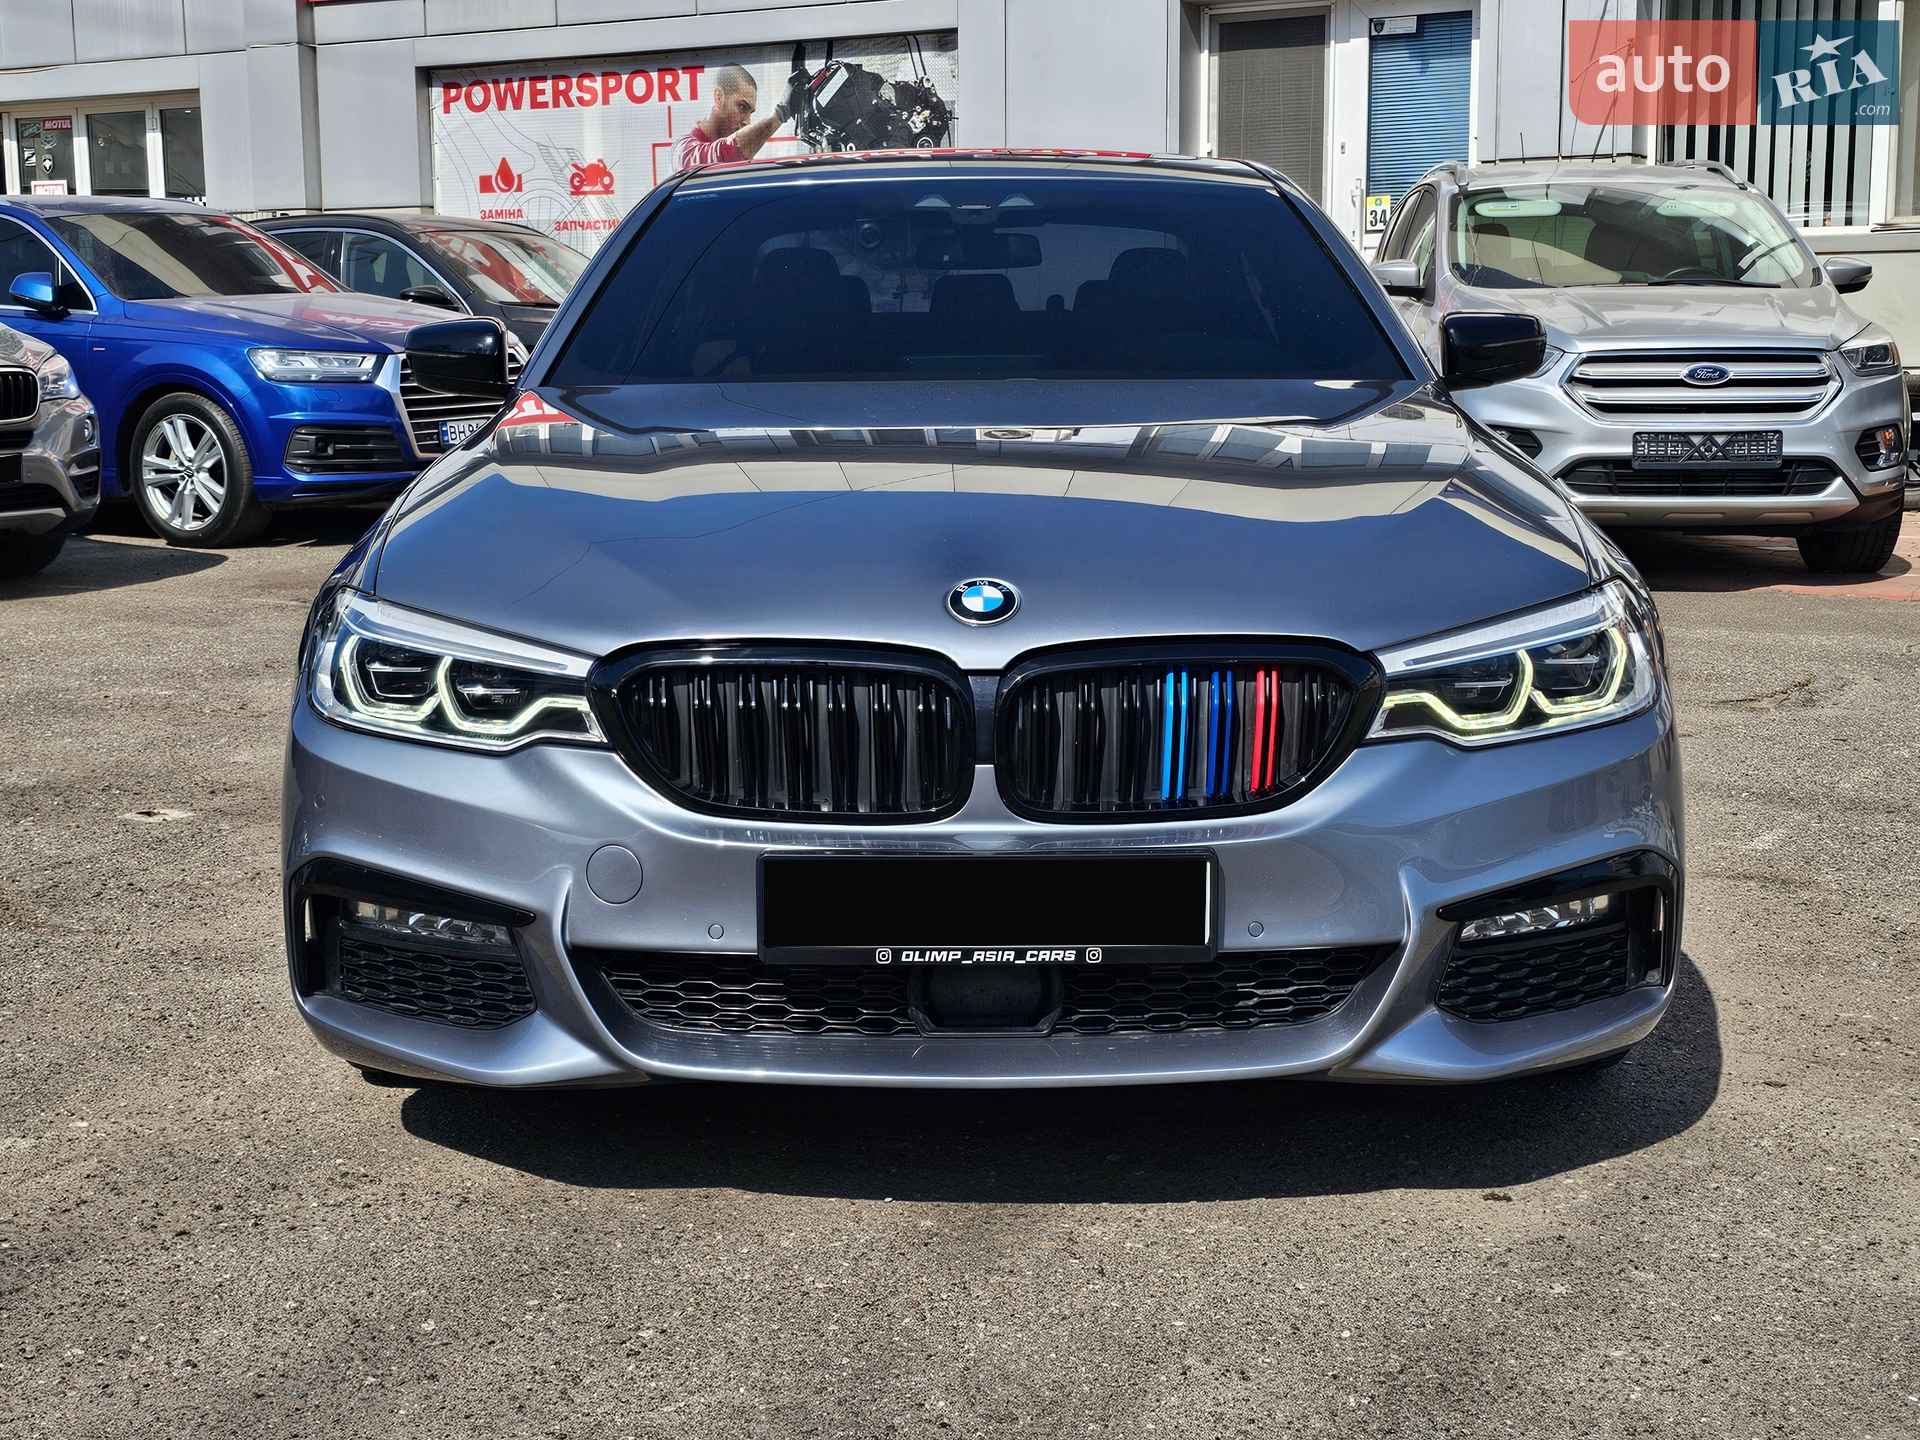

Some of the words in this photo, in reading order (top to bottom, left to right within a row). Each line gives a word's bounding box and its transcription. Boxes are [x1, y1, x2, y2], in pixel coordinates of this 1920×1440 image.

[442, 64, 706, 114] POWERSPORT
[44, 120, 72, 130] MOTUL
[480, 208, 524, 220] ЗАМІНА
[1369, 209, 1388, 227] 34
[1694, 368, 1720, 379] Ford
[955, 580, 1011, 593] BMW
[901, 950, 1077, 964] OLIMP_ASIA_CARS
